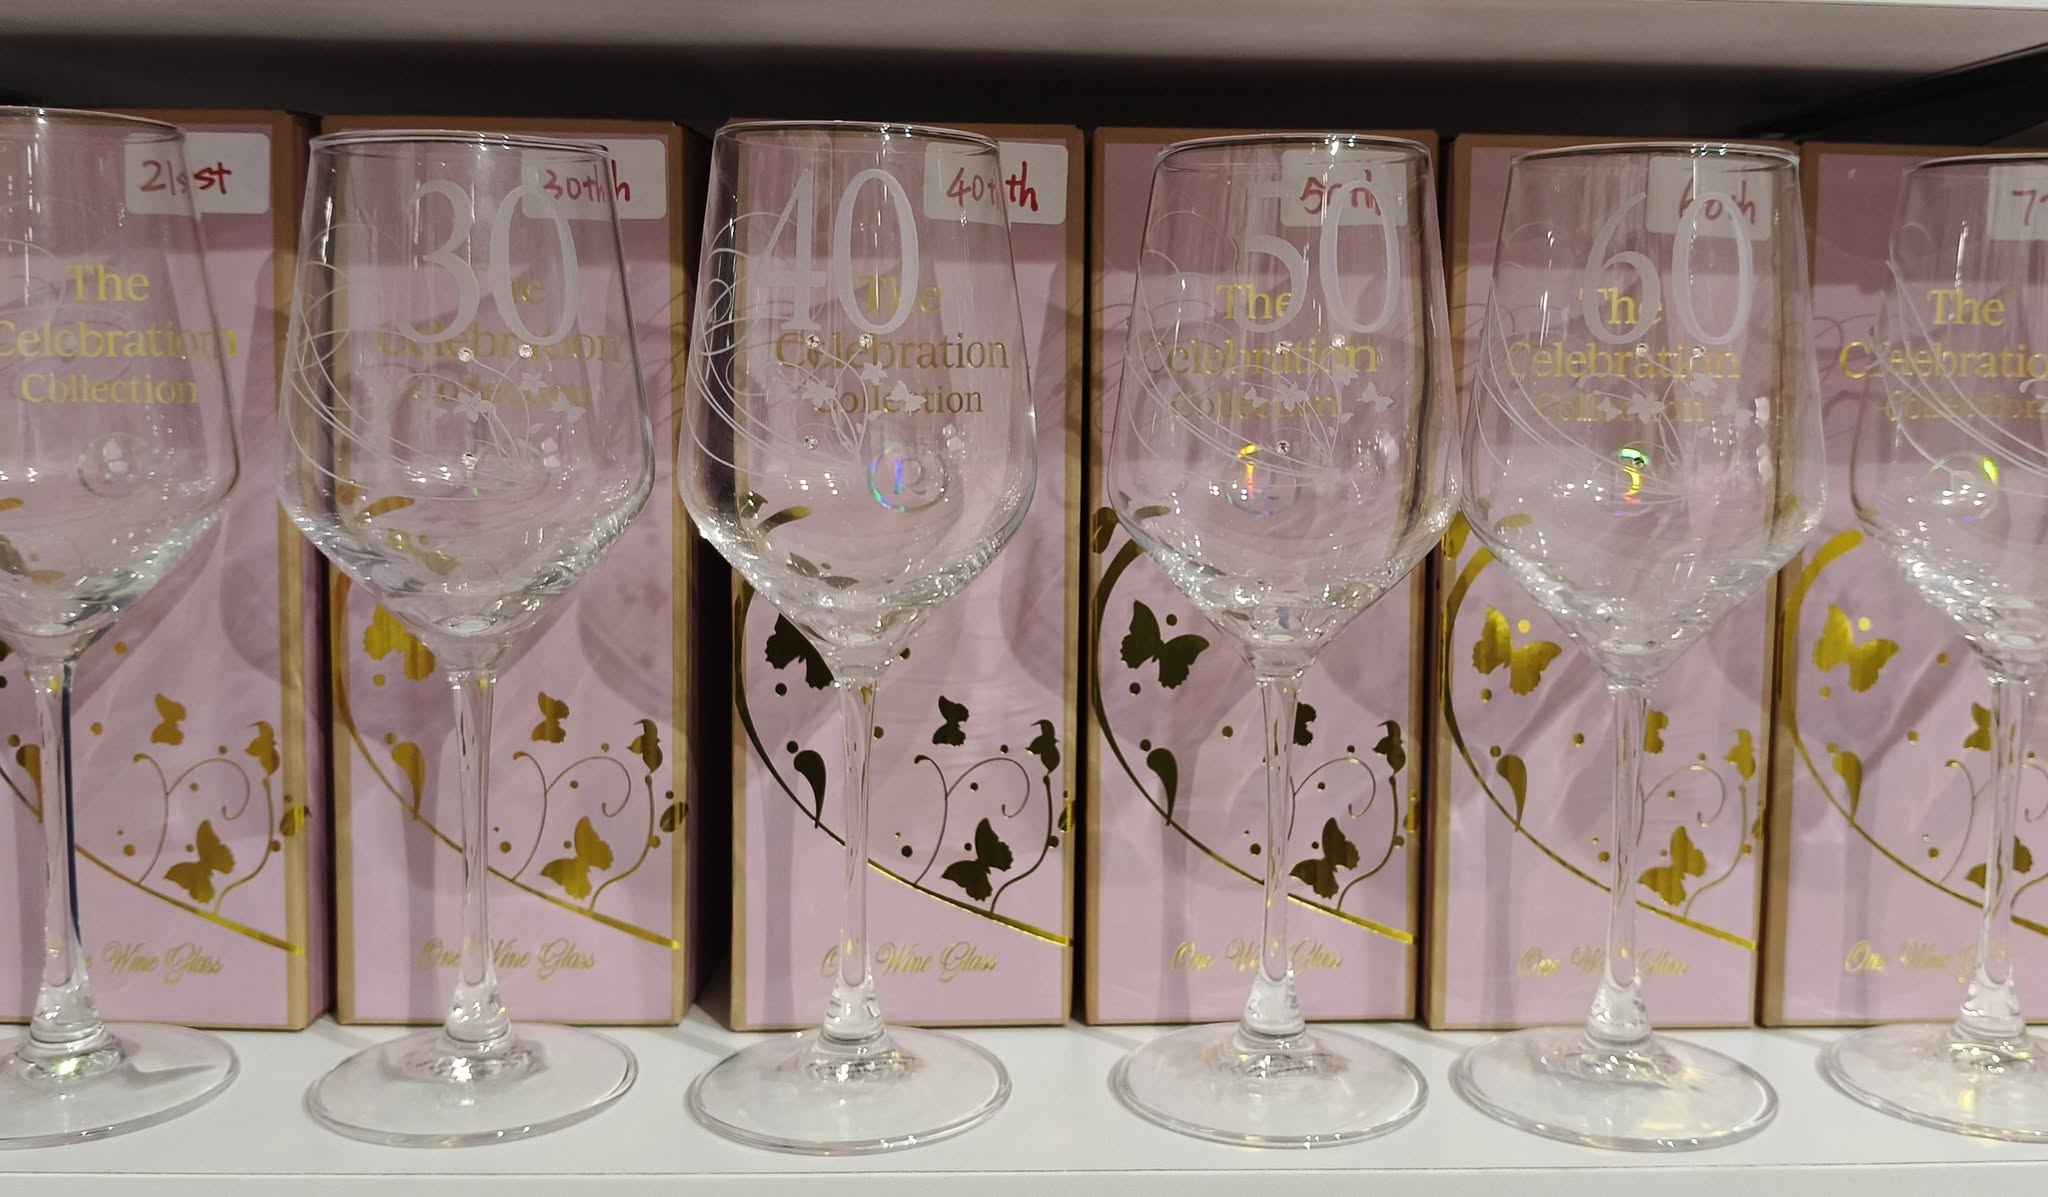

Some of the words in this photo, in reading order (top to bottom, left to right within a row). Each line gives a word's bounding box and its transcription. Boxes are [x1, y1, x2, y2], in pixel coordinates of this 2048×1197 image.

[2010, 189, 2048, 226] 7
[396, 179, 578, 345] 30
[757, 168, 919, 335] 40
[1233, 178, 1400, 333] 50
[1582, 191, 1753, 344] 60
[65, 263, 150, 302] The
[1216, 284, 1292, 321] The
[1927, 288, 2006, 327] The
[1506, 340, 1742, 380] Celebratin
[21, 373, 198, 405] Collection
[812, 384, 985, 415] olletion
[163, 942, 223, 985] Glass
[536, 937, 596, 981] Glass
[875, 941, 934, 977] Wine
[938, 941, 998, 984] Glass
